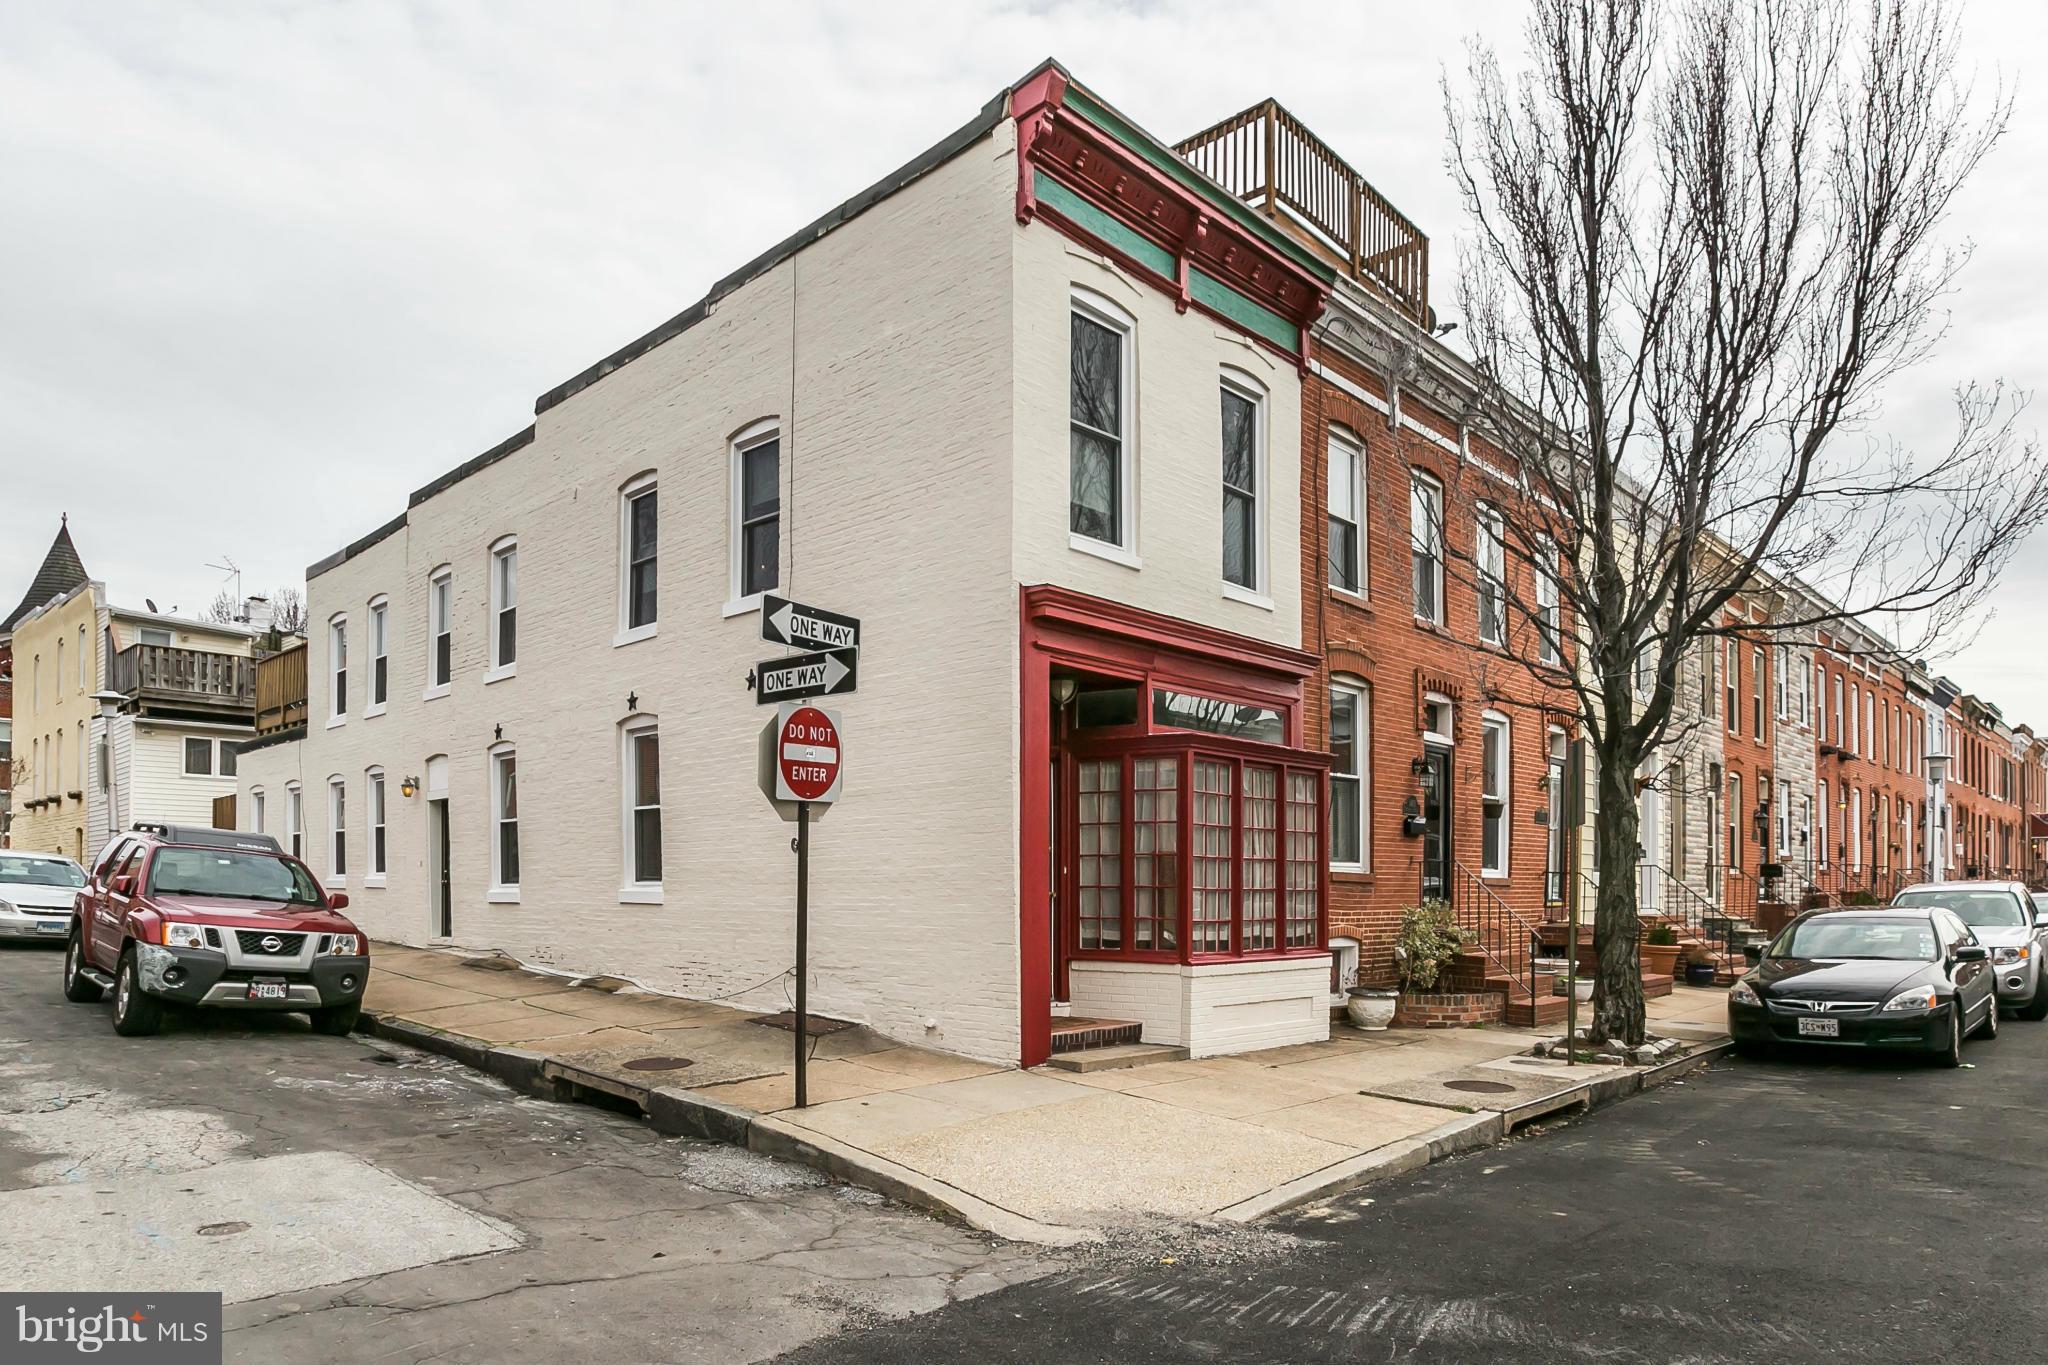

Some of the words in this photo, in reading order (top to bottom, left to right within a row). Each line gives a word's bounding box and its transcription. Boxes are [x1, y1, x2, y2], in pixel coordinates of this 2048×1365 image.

[790, 616, 818, 639] ONE
[822, 624, 852, 646] WAY
[766, 671, 793, 691] ONE
[797, 665, 827, 685] WAY
[789, 724, 805, 739] DO
[810, 727, 832, 742] NOT
[792, 766, 827, 782] ENTER
